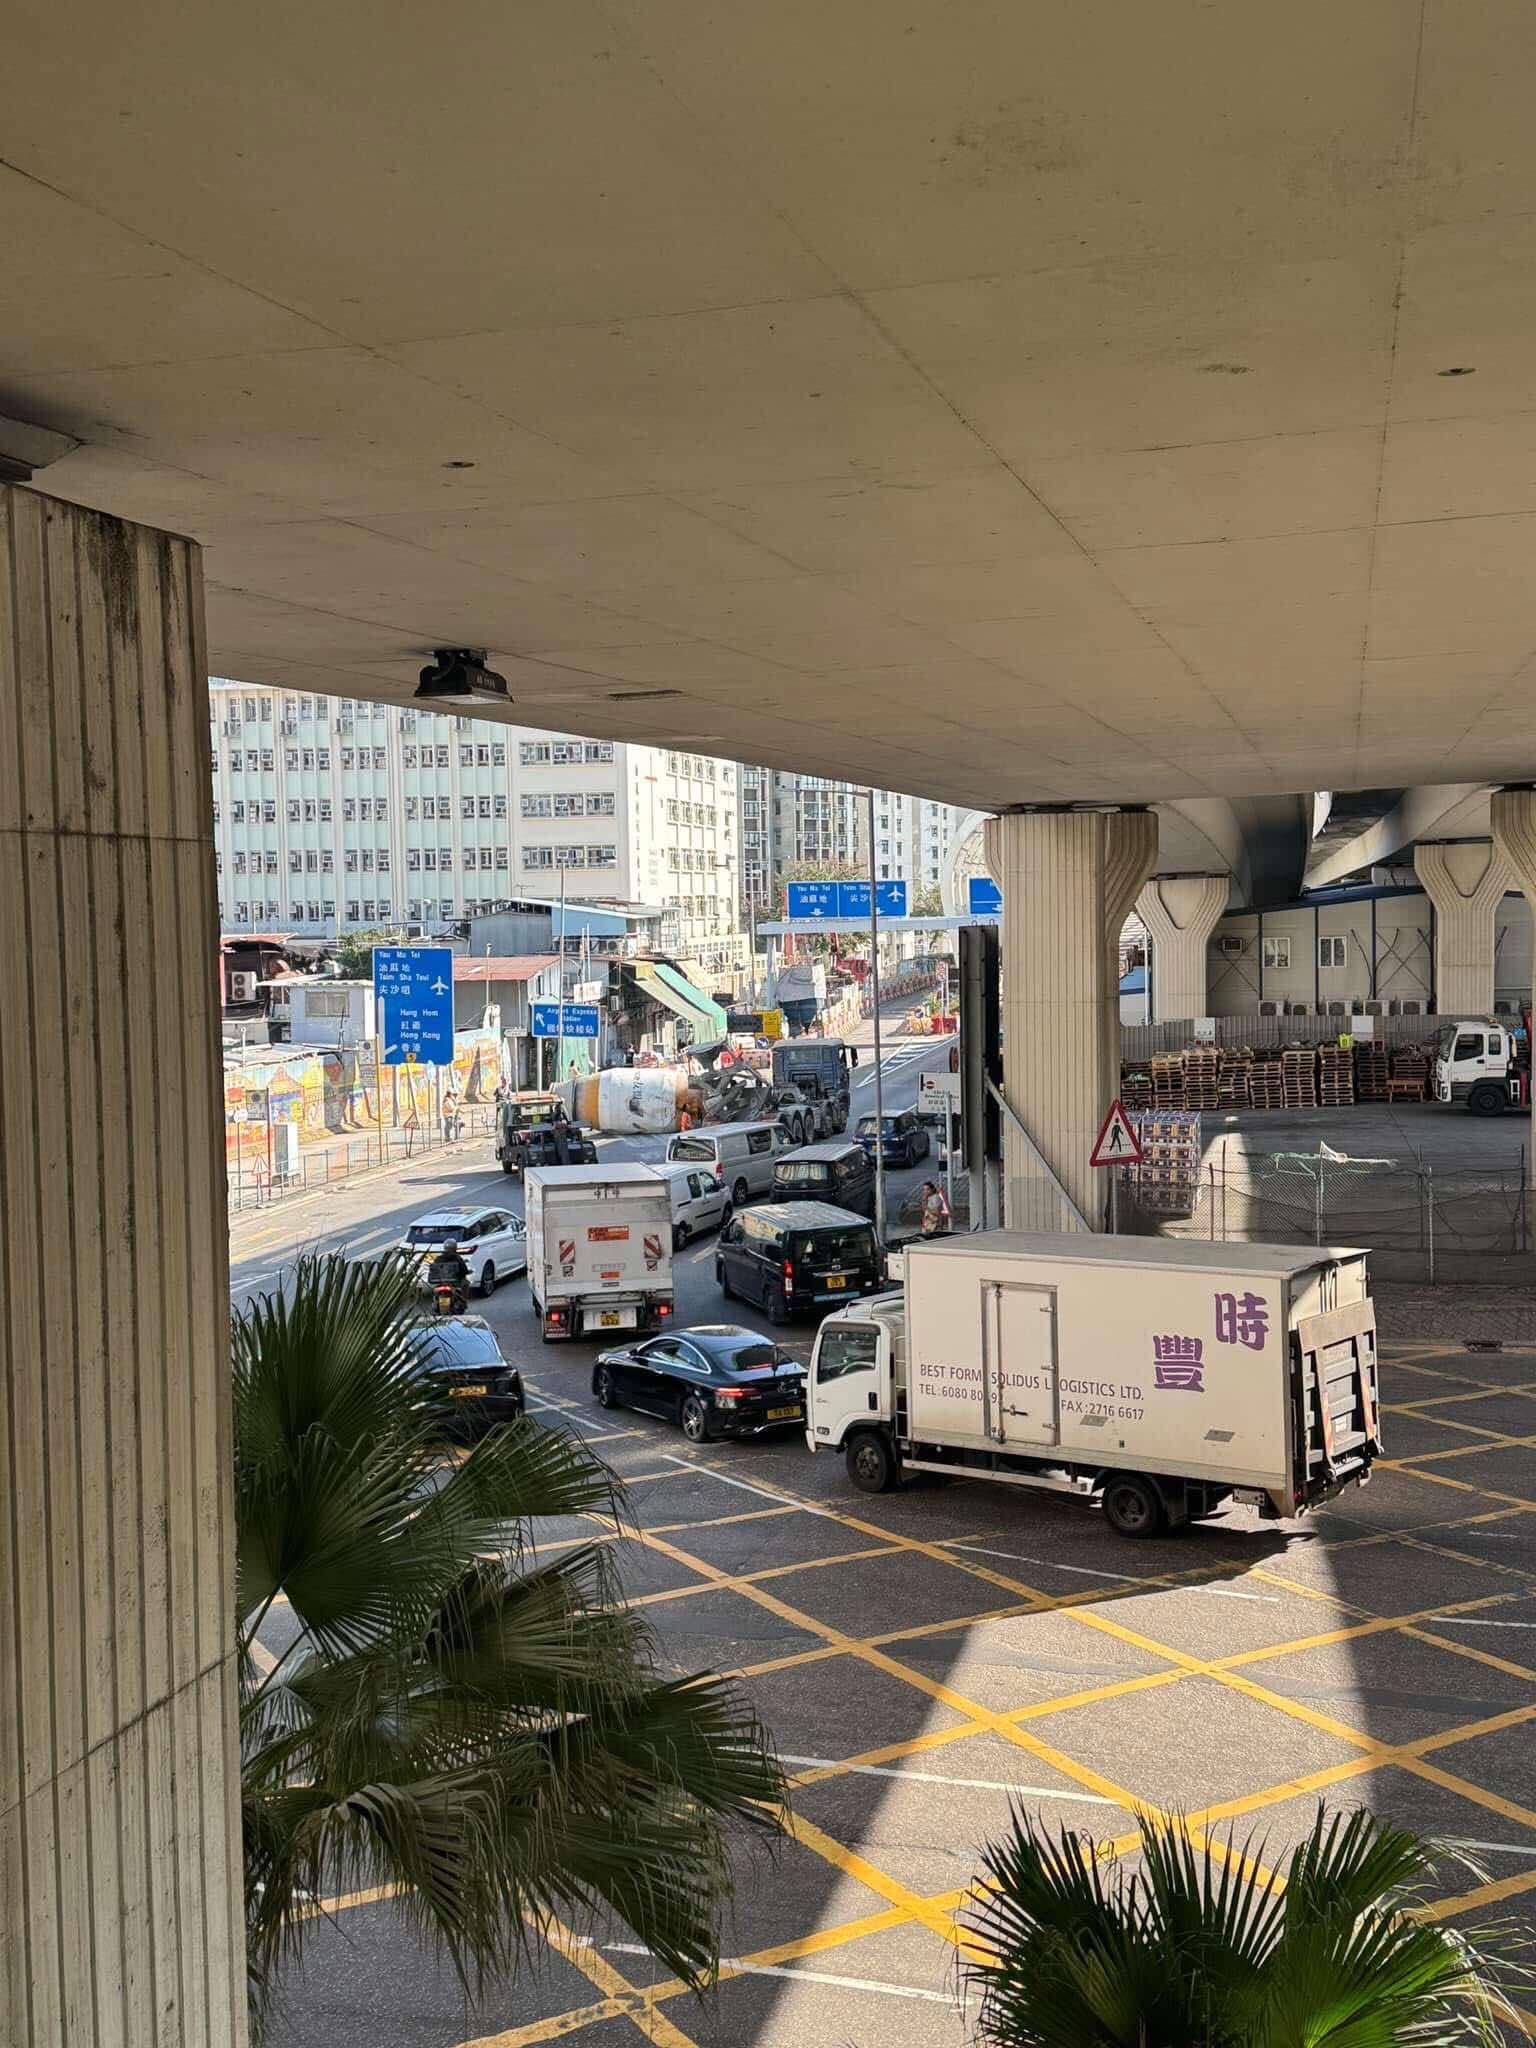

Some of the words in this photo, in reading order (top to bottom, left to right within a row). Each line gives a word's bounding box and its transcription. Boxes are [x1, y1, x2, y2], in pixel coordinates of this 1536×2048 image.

[379, 985, 411, 995] 尖沙咀
[400, 1031, 419, 1040] Hong
[422, 1031, 441, 1041] Kong
[1214, 1292, 1269, 1351] 時
[1152, 1335, 1205, 1393] 豐
[919, 1364, 946, 1378] BEST
[950, 1367, 982, 1382] FORM
[991, 1371, 1040, 1389] SOLIDUS
[1120, 1385, 1144, 1401] LTD.
[1118, 1406, 1144, 1421] 6617
